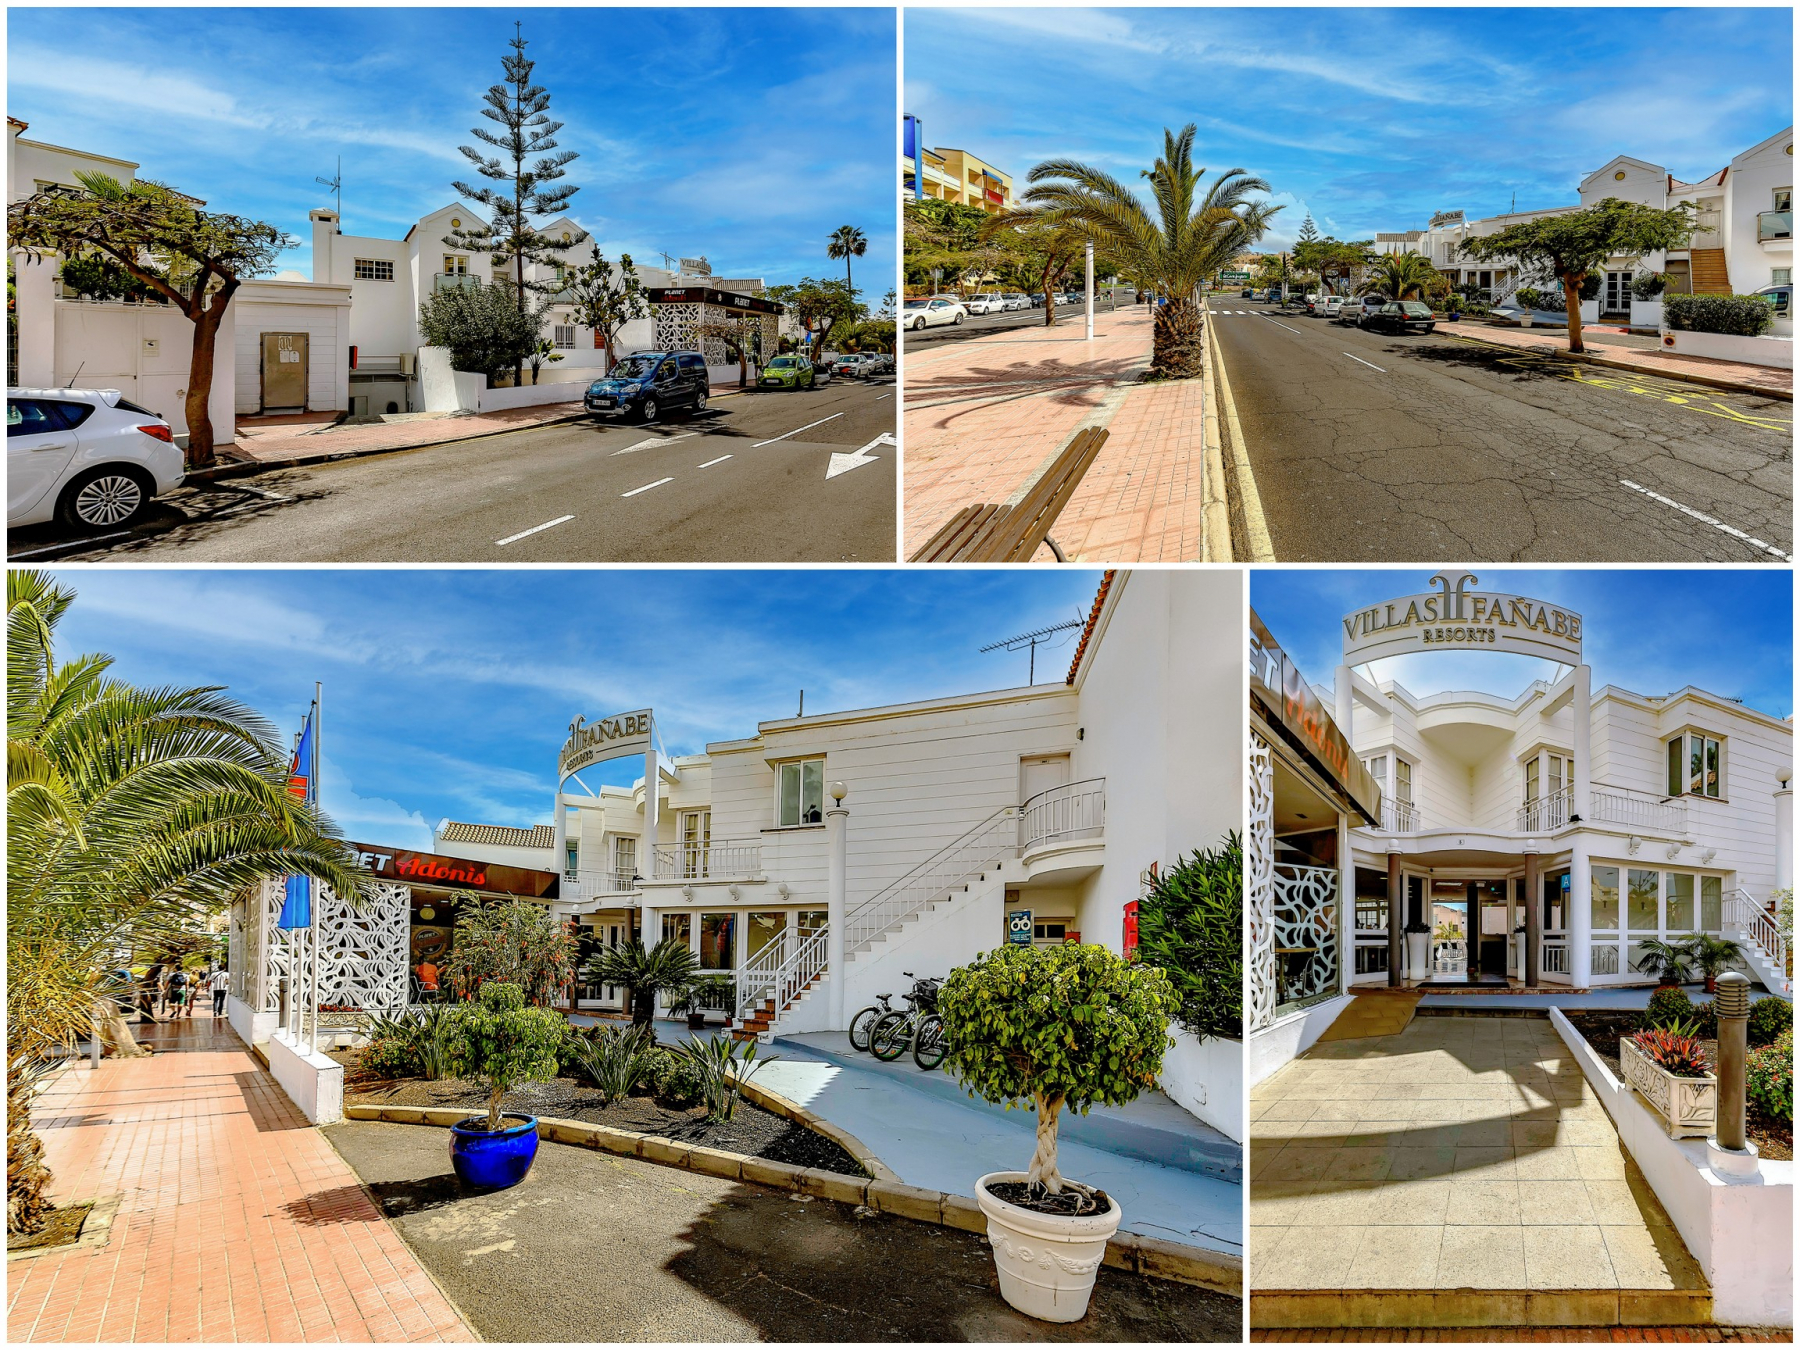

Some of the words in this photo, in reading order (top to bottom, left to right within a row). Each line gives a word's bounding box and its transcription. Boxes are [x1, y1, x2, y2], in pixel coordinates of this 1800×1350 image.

[681, 259, 702, 270] VILLAS
[1343, 597, 1438, 642] VILLAS
[1471, 597, 1583, 642] FAÑABE
[1422, 627, 1496, 643] RESORTS
[580, 714, 650, 750] FAÑABE
[395, 858, 486, 885] Adonis
